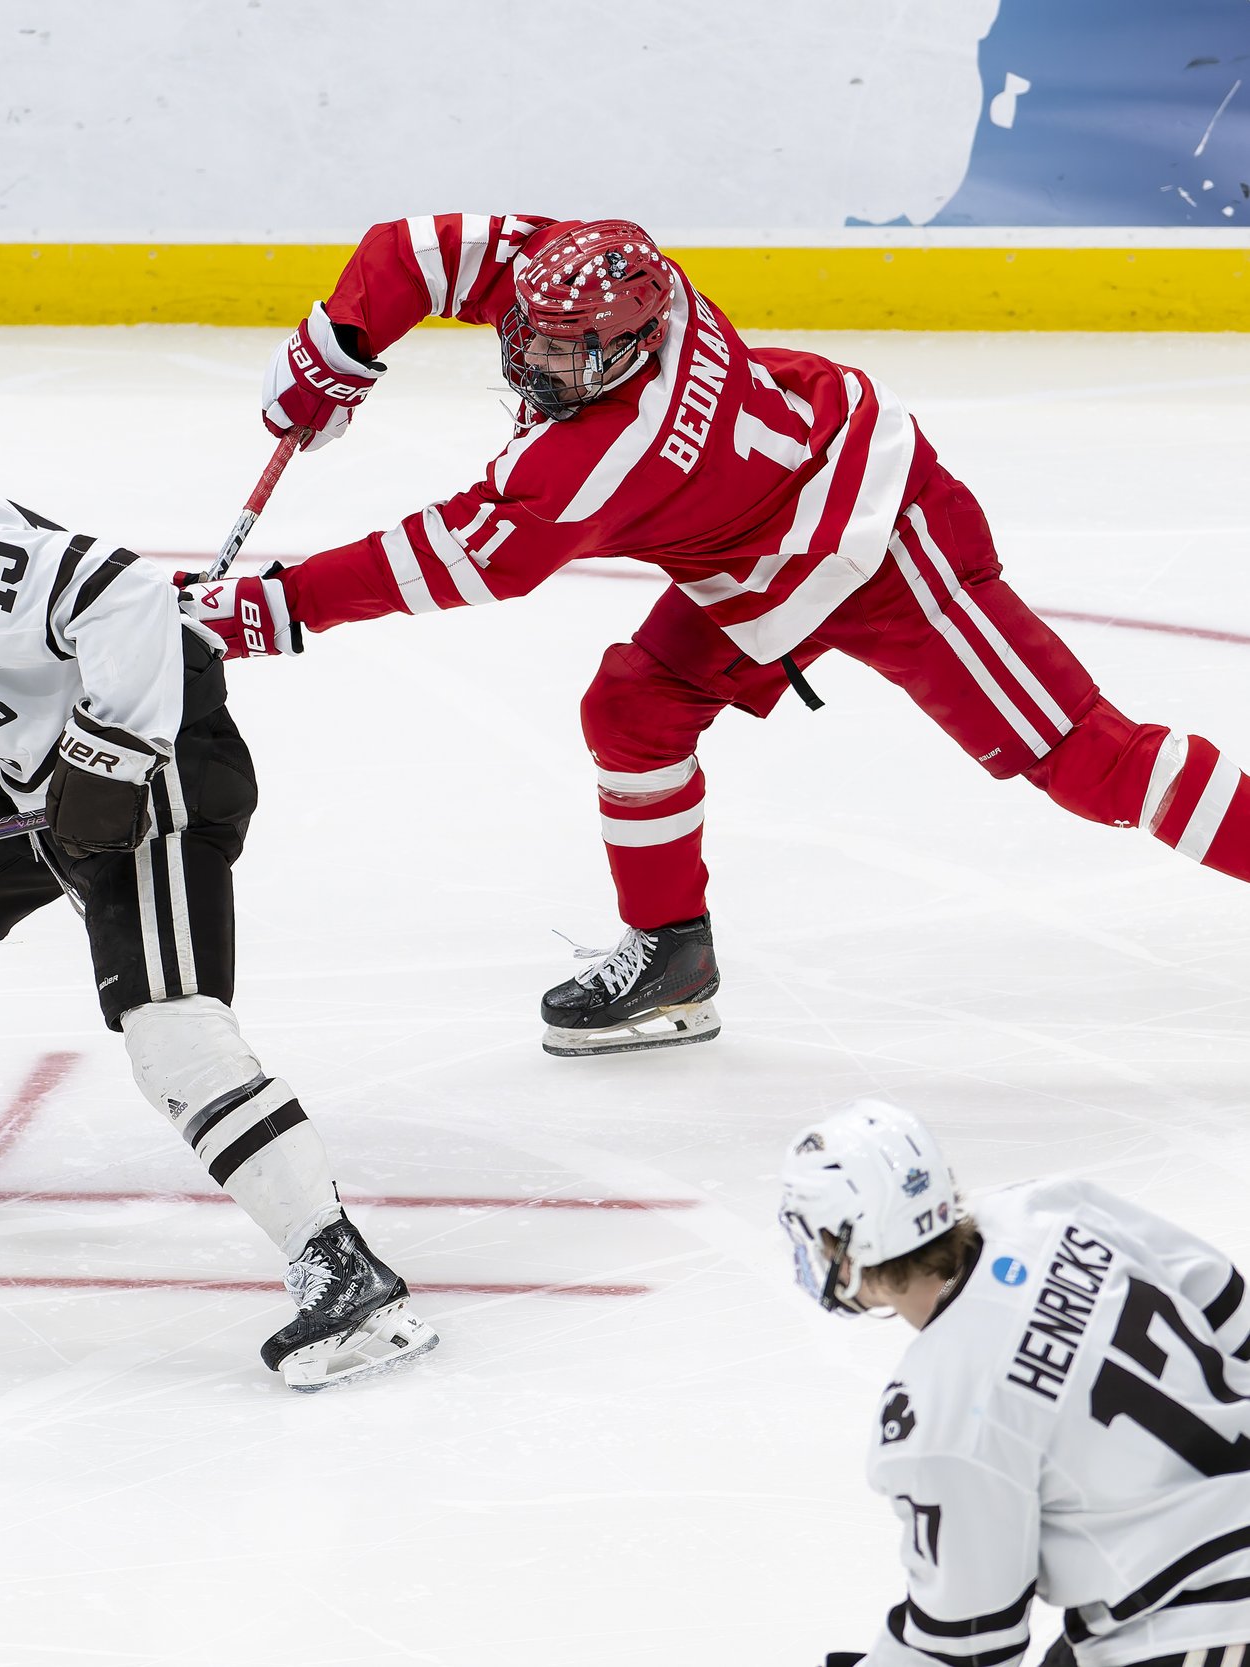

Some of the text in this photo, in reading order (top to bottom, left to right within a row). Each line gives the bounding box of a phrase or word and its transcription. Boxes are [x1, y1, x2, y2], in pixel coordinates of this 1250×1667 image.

[659, 281, 730, 474] BEDNAR
[450, 502, 517, 569] 11
[913, 1209, 933, 1236] 17
[1007, 1225, 1114, 1402] HENRICKS
